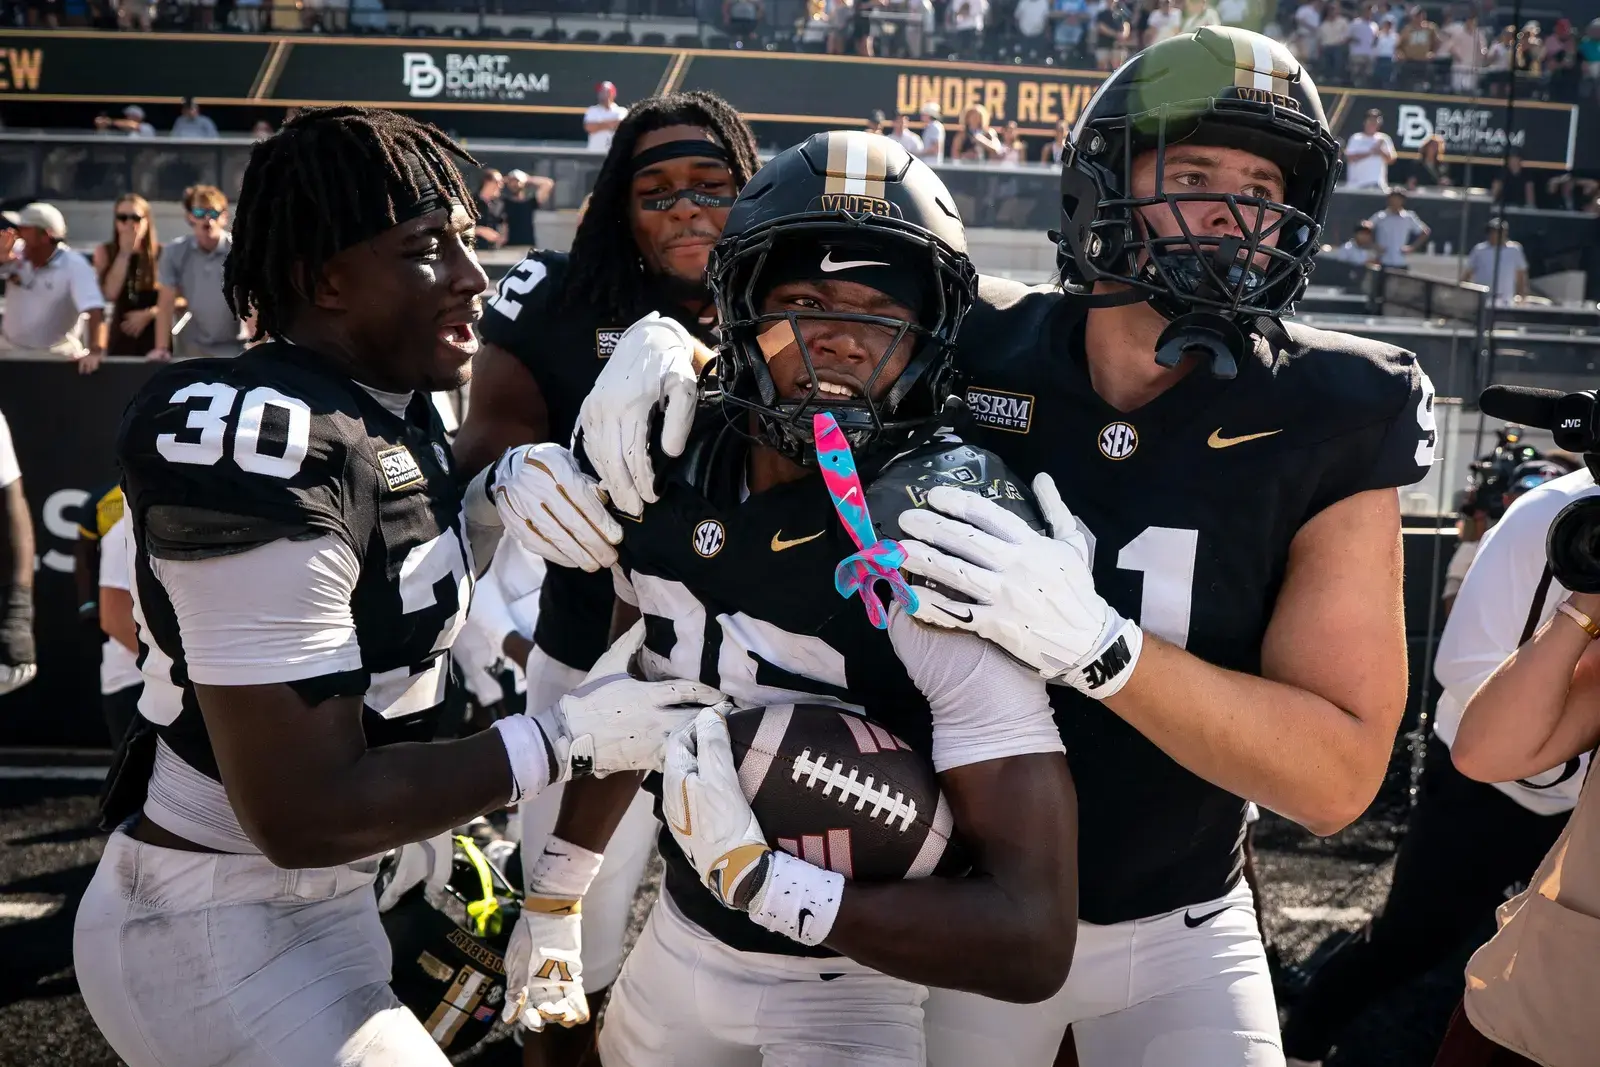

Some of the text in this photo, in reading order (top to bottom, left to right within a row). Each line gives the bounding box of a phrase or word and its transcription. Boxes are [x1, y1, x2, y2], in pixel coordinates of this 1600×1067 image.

[446, 53, 511, 73] BART
[445, 70, 550, 93] DURHAM
[897, 74, 1100, 124] UNDER REVI
[1436, 106, 1493, 128] BART
[1435, 124, 1527, 147] DURHAM
[978, 393, 1031, 420] SRM
[156, 382, 311, 479] 30
[973, 413, 1028, 428] NCRETE
[1561, 418, 1581, 428] JVC
[1101, 424, 1135, 457] SEC
[695, 522, 723, 555] SEC
[1082, 634, 1132, 690] NIKE
[446, 928, 506, 976] DERBILT
